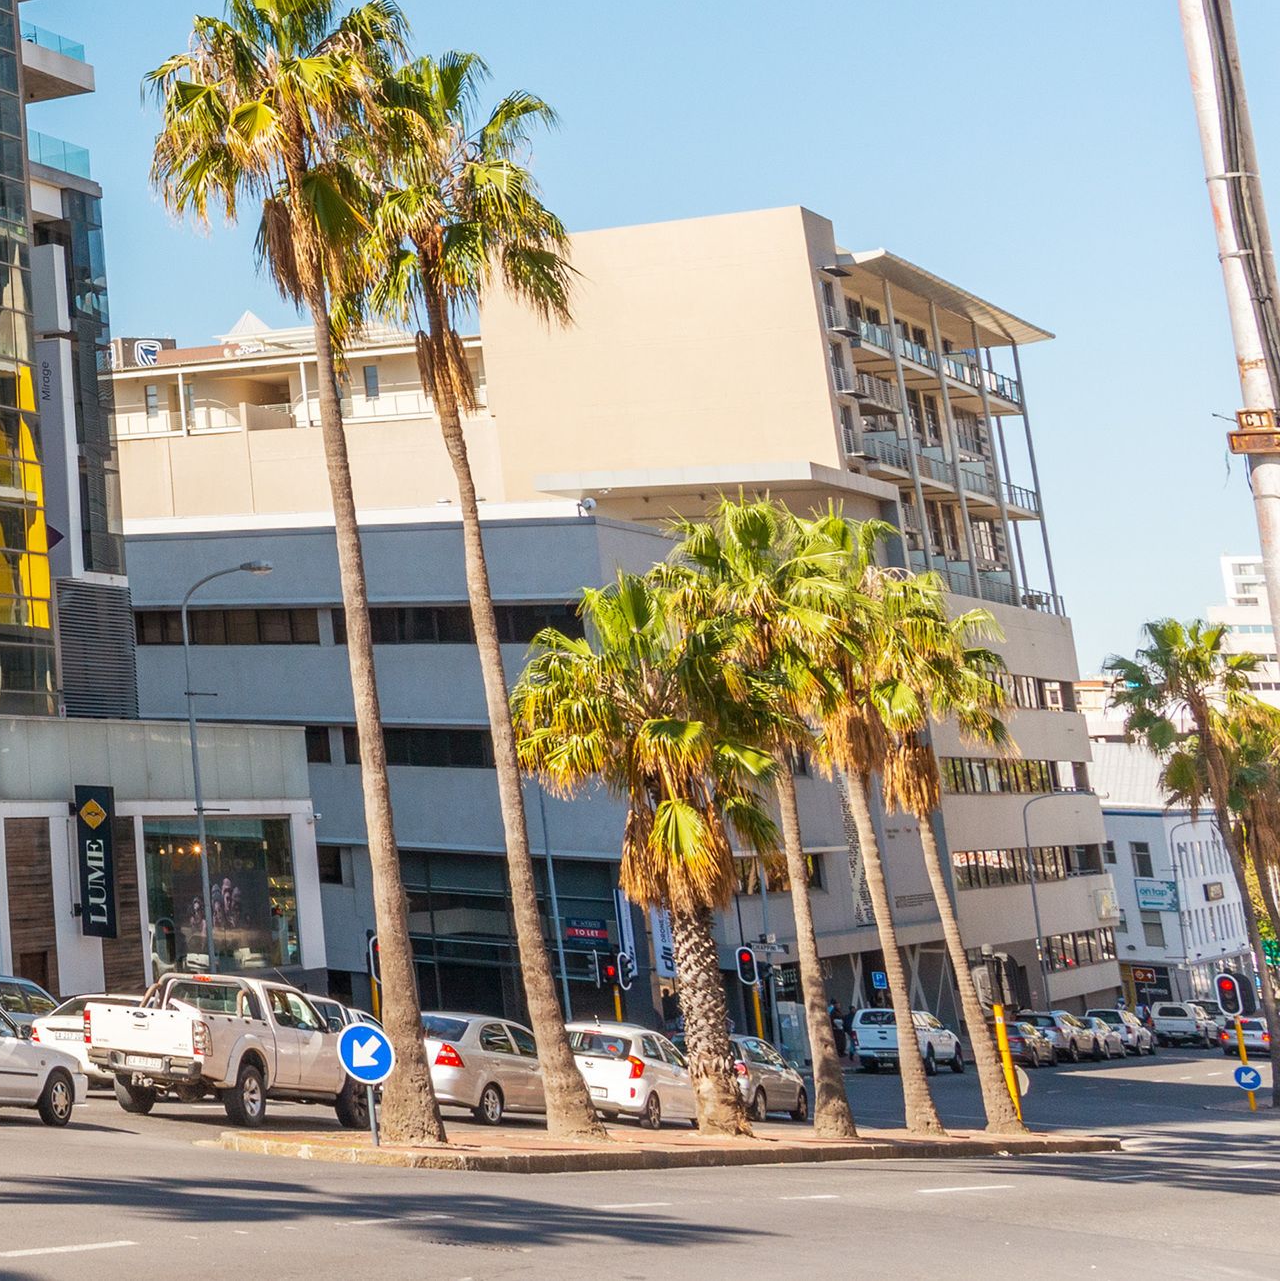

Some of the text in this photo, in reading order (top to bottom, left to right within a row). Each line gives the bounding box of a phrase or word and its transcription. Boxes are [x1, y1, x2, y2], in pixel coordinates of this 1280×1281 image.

[42, 361, 52, 401] Mirage
[86, 839, 108, 925] LUME
[1152, 888, 1167, 898] tap
[574, 928, 599, 937] TO LET
